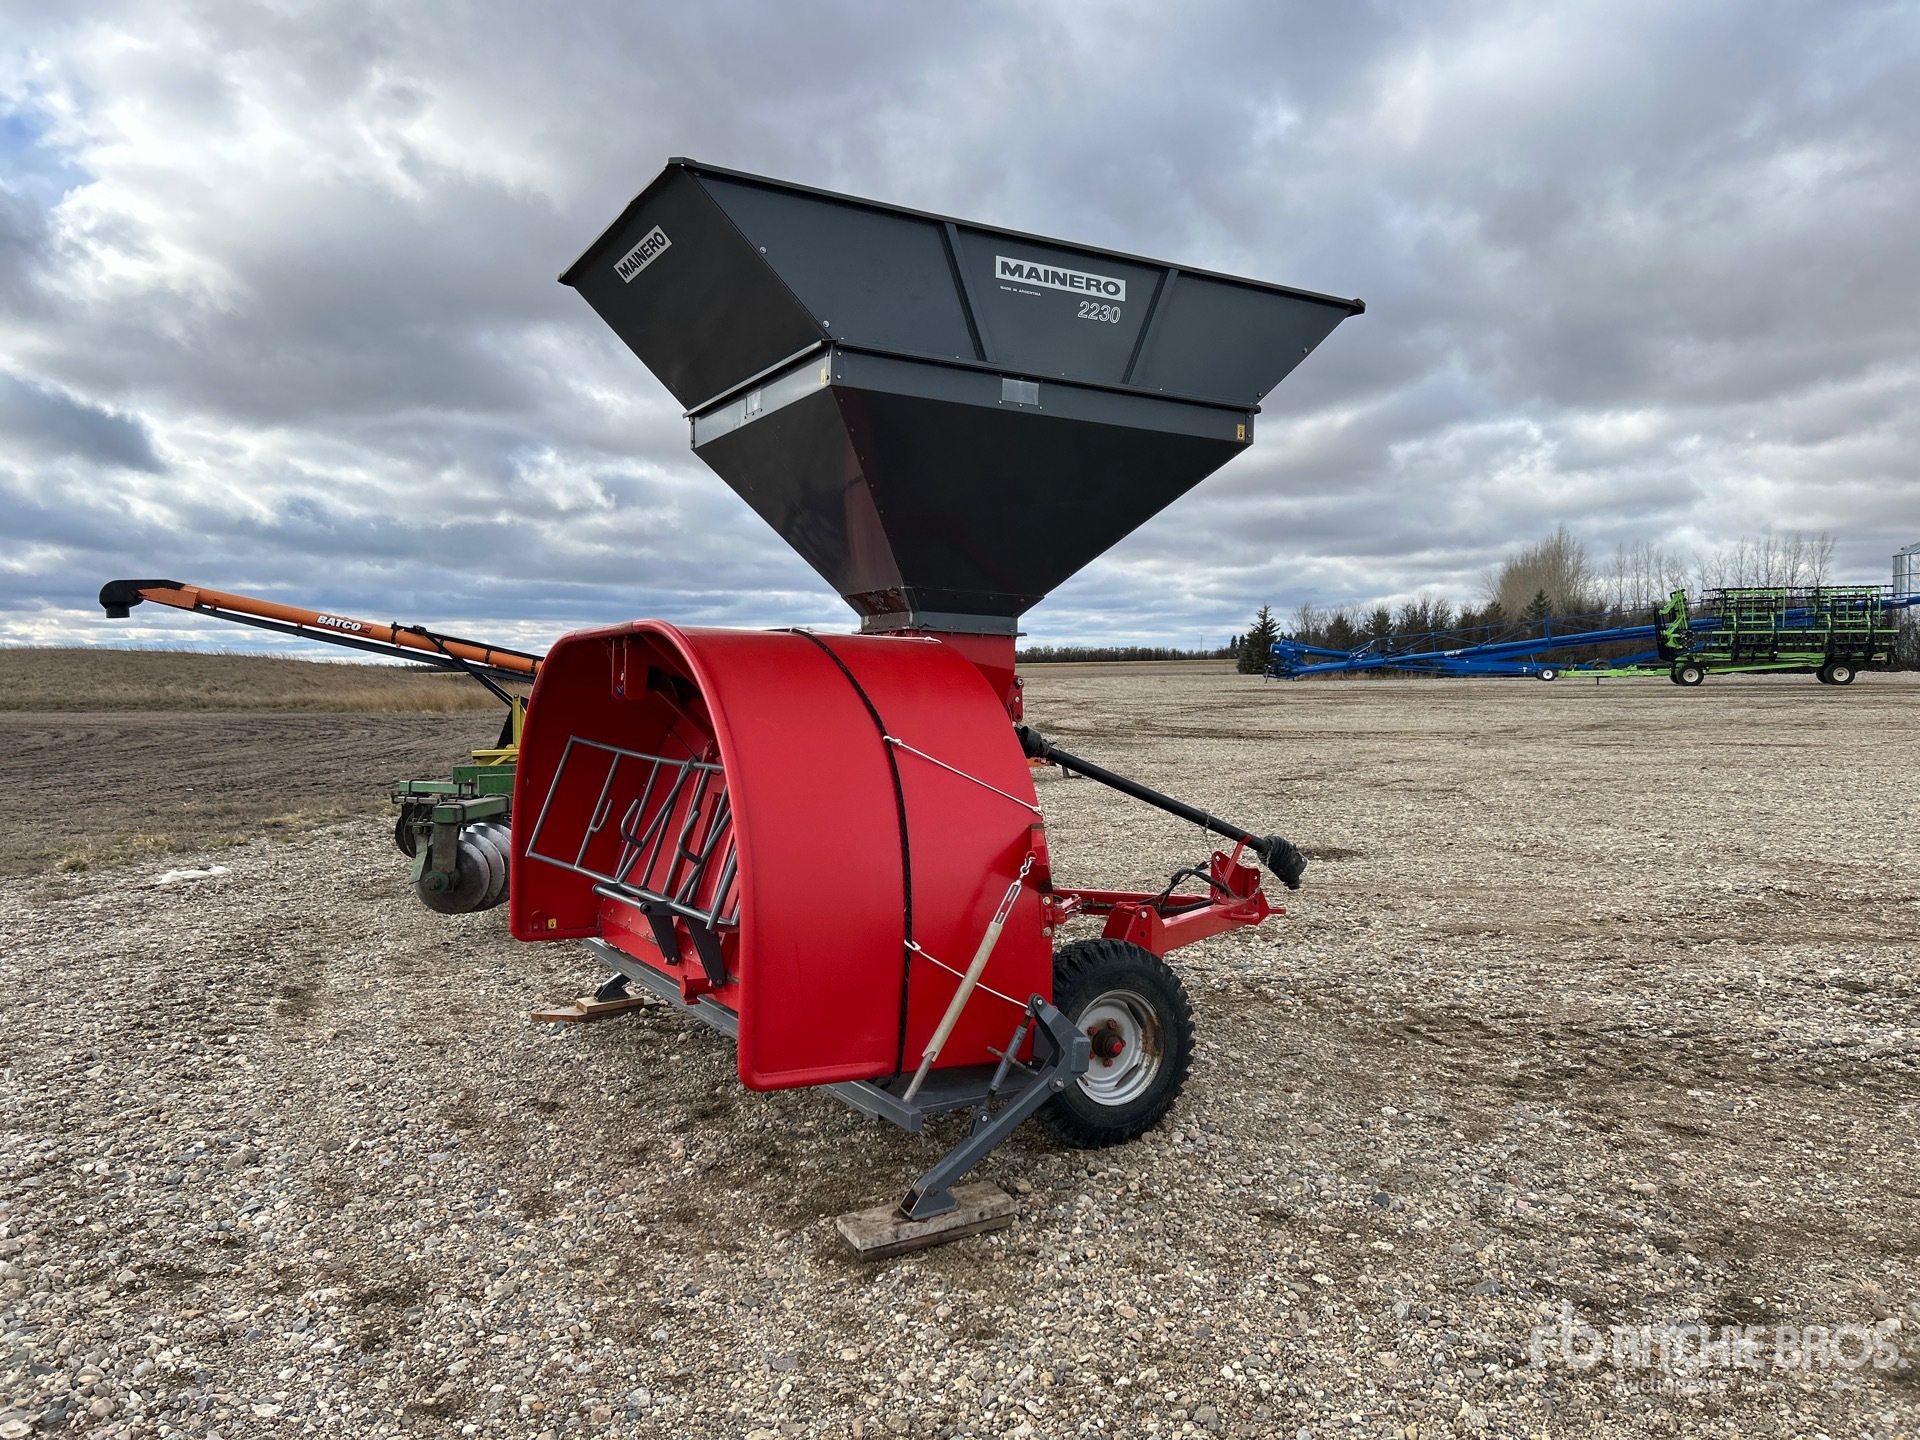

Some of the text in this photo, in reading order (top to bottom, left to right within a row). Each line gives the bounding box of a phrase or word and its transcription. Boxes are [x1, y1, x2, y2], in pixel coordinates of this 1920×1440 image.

[617, 231, 666, 279] MAINERO
[1000, 260, 1121, 296] MAINERO
[1077, 300, 1121, 324] 2230
[316, 615, 362, 631] BATCO
